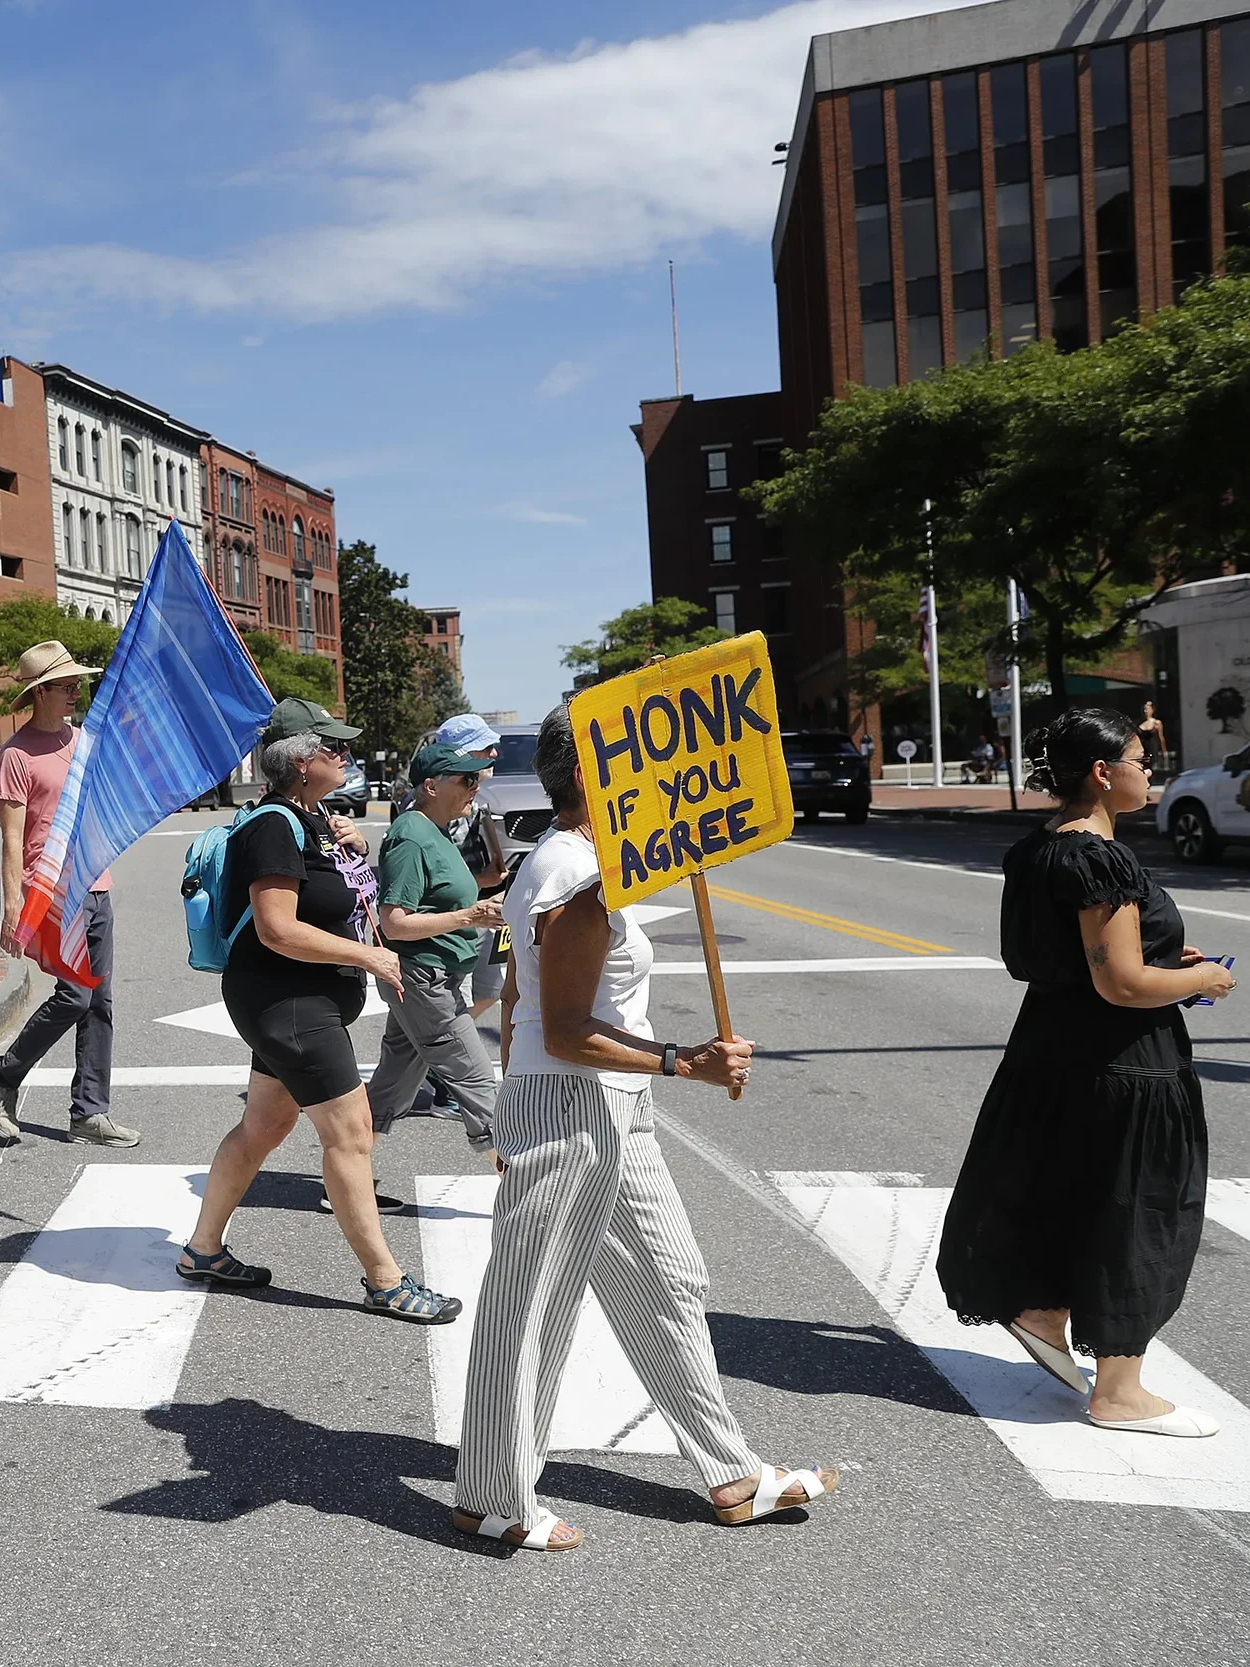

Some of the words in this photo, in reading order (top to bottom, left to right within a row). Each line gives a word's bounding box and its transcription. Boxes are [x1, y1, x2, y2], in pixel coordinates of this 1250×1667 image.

[590, 667, 772, 789] HONK
[607, 789, 640, 835] IF
[658, 754, 741, 820] YOU
[621, 798, 762, 889] AGREE
